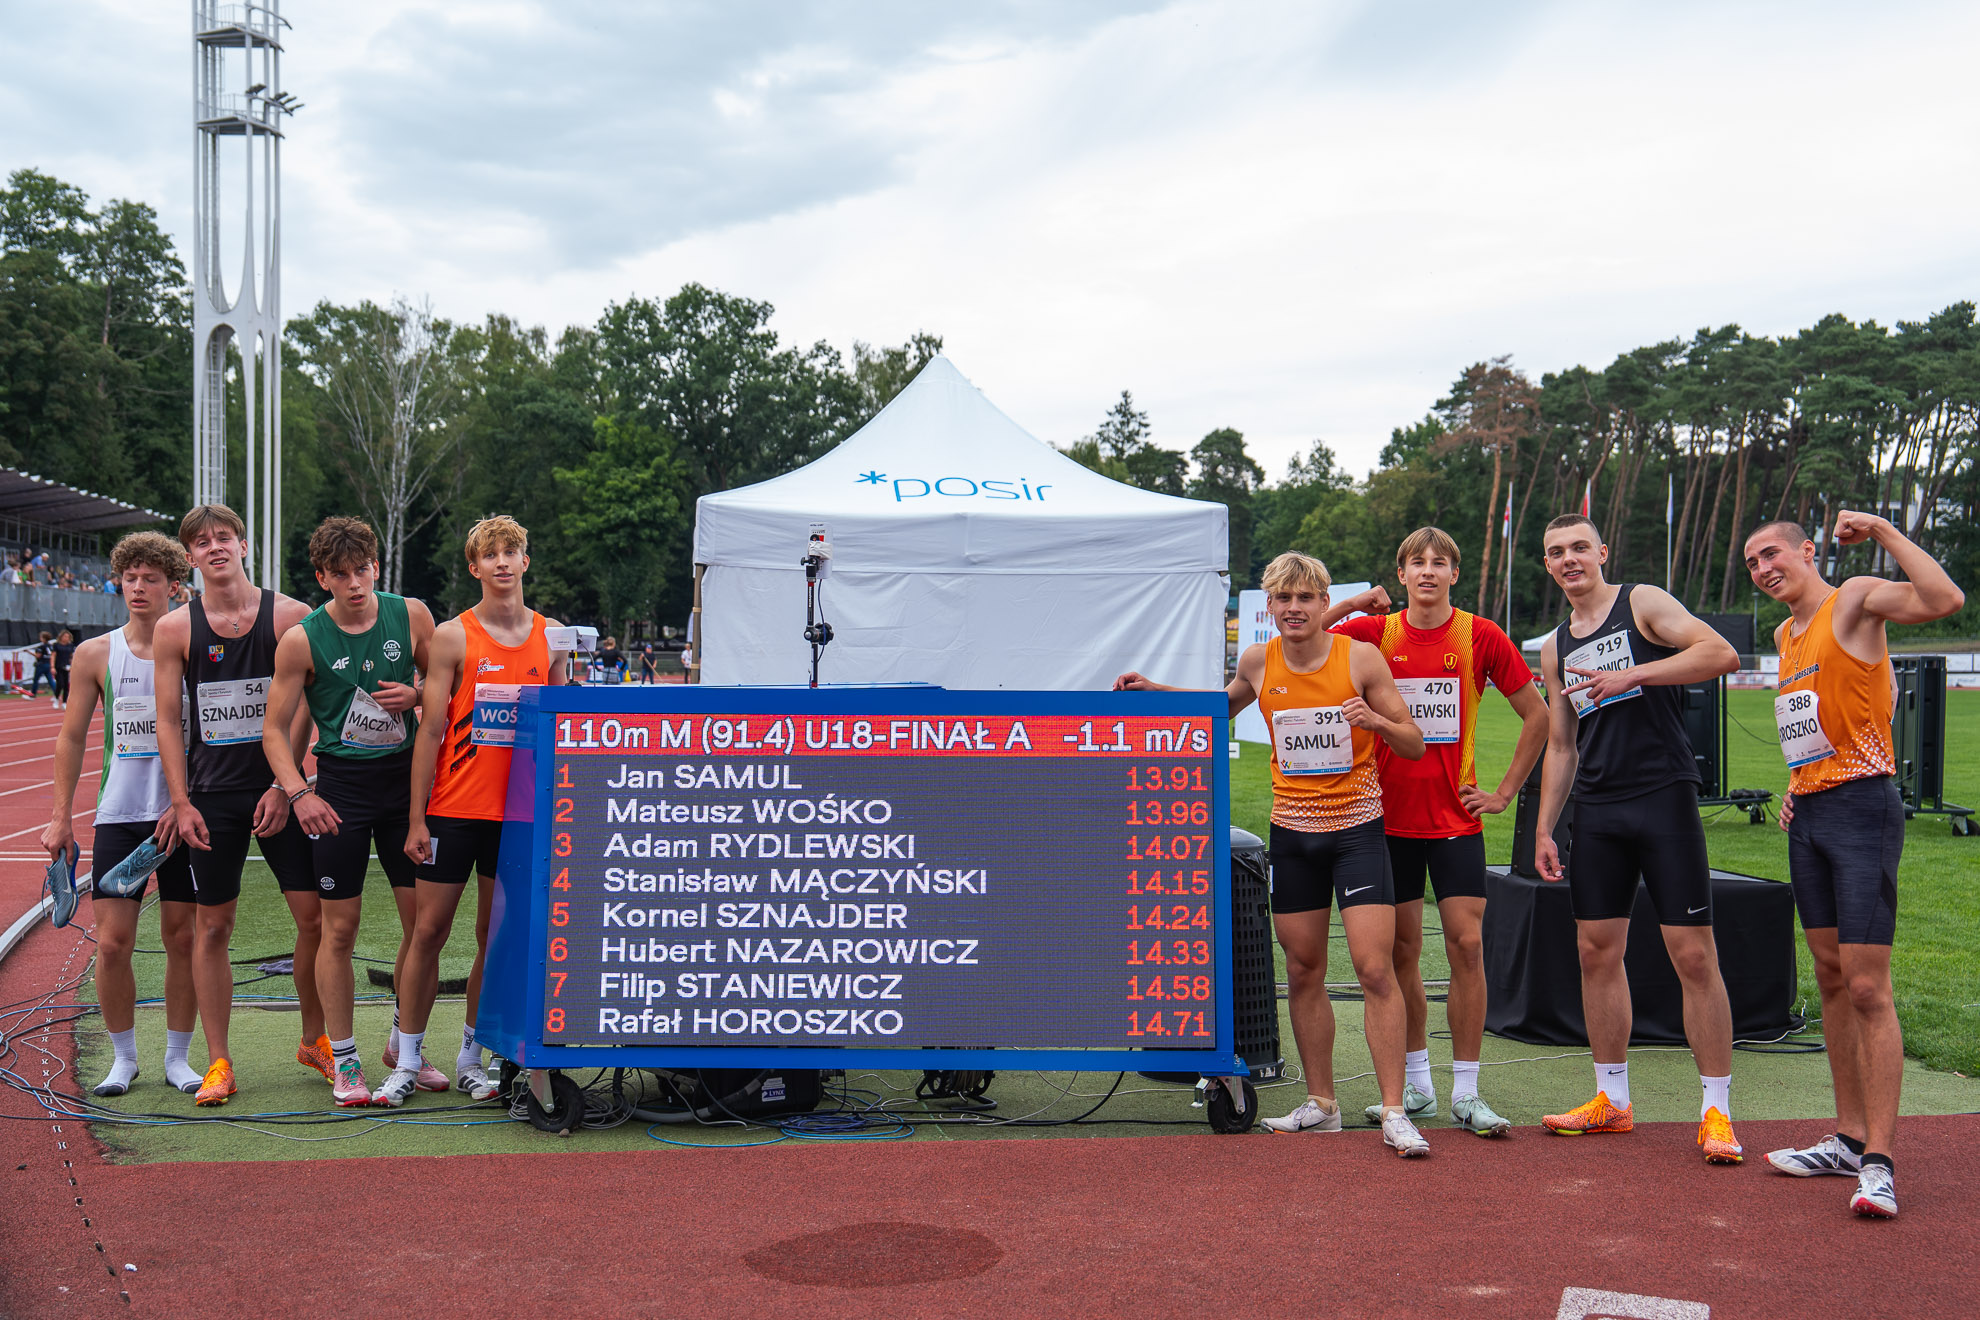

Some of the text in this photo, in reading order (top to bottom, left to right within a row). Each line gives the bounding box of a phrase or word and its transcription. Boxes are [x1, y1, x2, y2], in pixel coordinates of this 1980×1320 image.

[1596, 637, 1622, 656] 919
[245, 682, 264, 696] 54
[1424, 682, 1453, 695] 470
[480, 706, 518, 724] WOŚ
[1410, 704, 1456, 718] LEWSKI
[1788, 694, 1811, 712] 388
[1314, 711, 1343, 724] 391
[558, 720, 648, 747] 110m
[661, 720, 691, 747] M
[703, 717, 794, 754] (91.4)
[1005, 722, 1031, 749] A
[1064, 722, 1131, 750] -1.1
[1146, 723, 1207, 751] m/s
[1284, 733, 1341, 751] SAMUL
[558, 764, 1207, 790] 1 Jan SAMUL 13.91
[556, 794, 1208, 825] 2 Mateusz WOŚKO 13.96
[555, 833, 1209, 859] 3 Adam RYDLEWSKI 14.07
[553, 863, 1208, 900] 4 Stanisław MĄCZYŃSKI 14.15
[552, 902, 1210, 929] 5 Kornel SZNAJDER 14.24
[551, 938, 1209, 964] 6 Hubert NAZAROWICZ 14.33
[551, 973, 1209, 1005] 7 Filip STANIEWICZ 14.58
[547, 1008, 1210, 1036] 8 Rafał HOROSZKO 14.71
